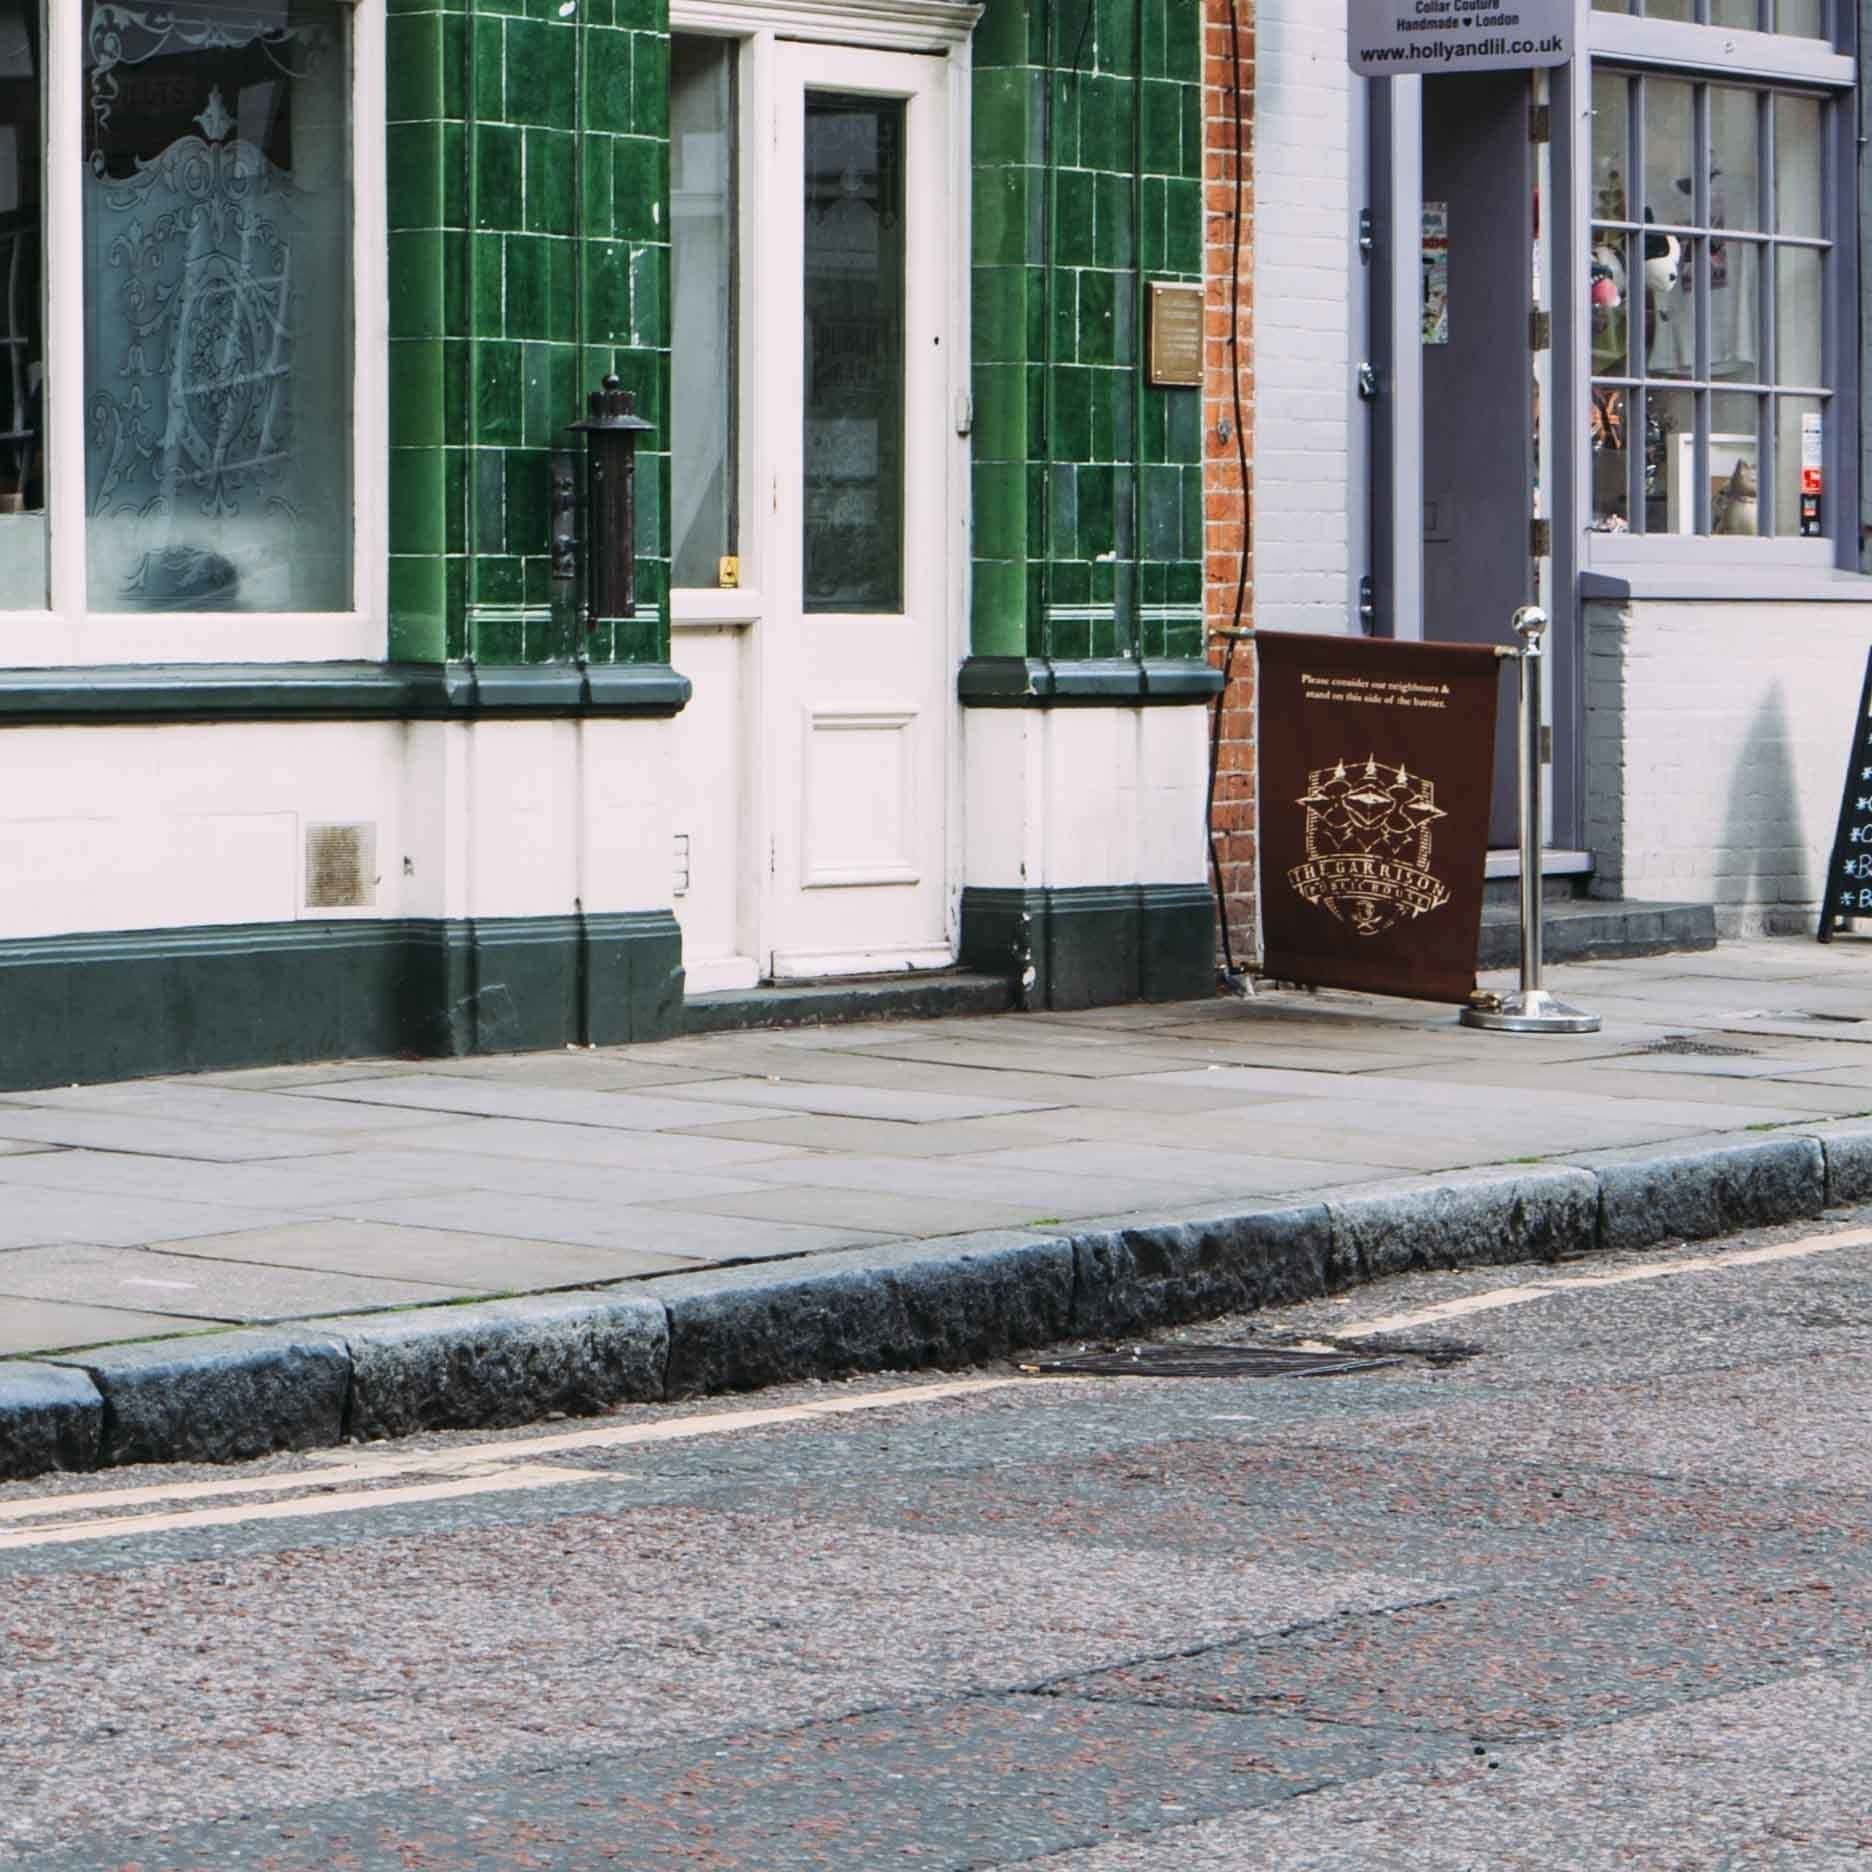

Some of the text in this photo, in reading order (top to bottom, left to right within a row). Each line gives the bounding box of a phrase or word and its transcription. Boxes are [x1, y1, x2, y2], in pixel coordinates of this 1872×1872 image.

[1415, 0, 1451, 15] Collar
[1396, 13, 1520, 33] Handmade London
[1360, 34, 1563, 64] www.hollyandlil.co.uk
[1301, 673, 1329, 686] Please
[1331, 678, 1369, 689] consider
[1305, 690, 1331, 700] stand
[1291, 861, 1446, 897] THE GARRISON
